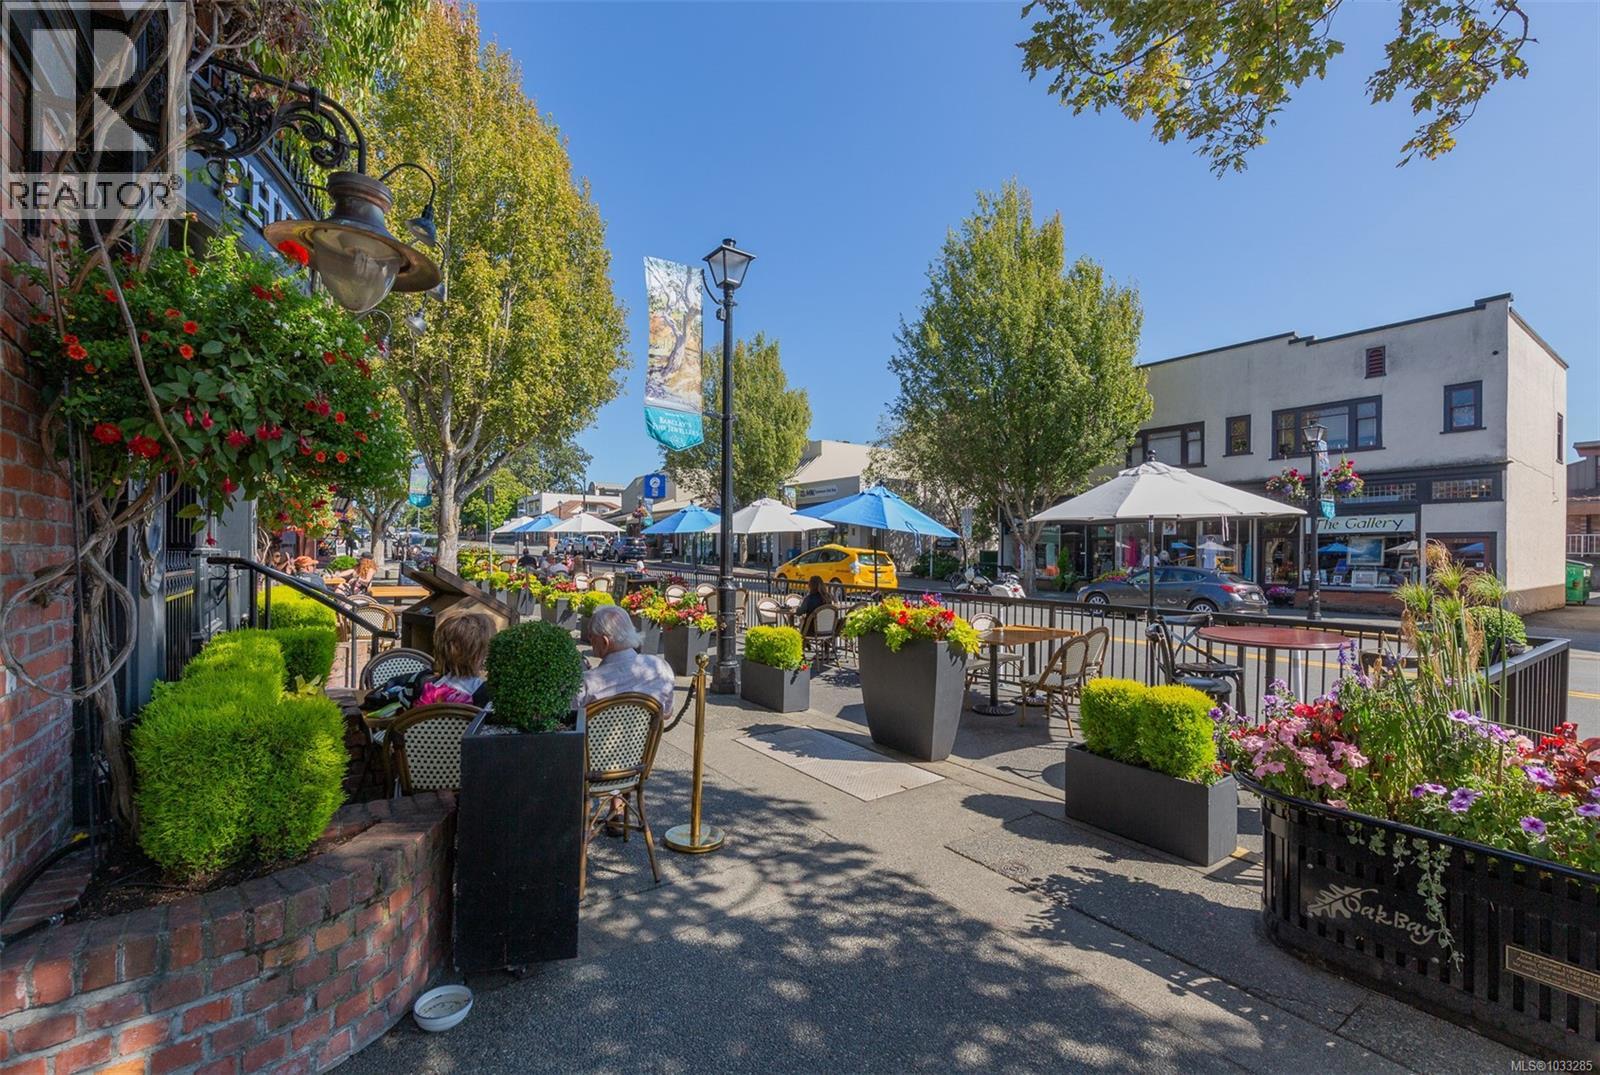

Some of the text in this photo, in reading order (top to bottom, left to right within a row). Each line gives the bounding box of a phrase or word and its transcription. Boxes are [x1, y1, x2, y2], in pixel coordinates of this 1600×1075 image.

[1316, 517, 1404, 531] The Gallery
[1343, 891, 1440, 946] Oak Bay
